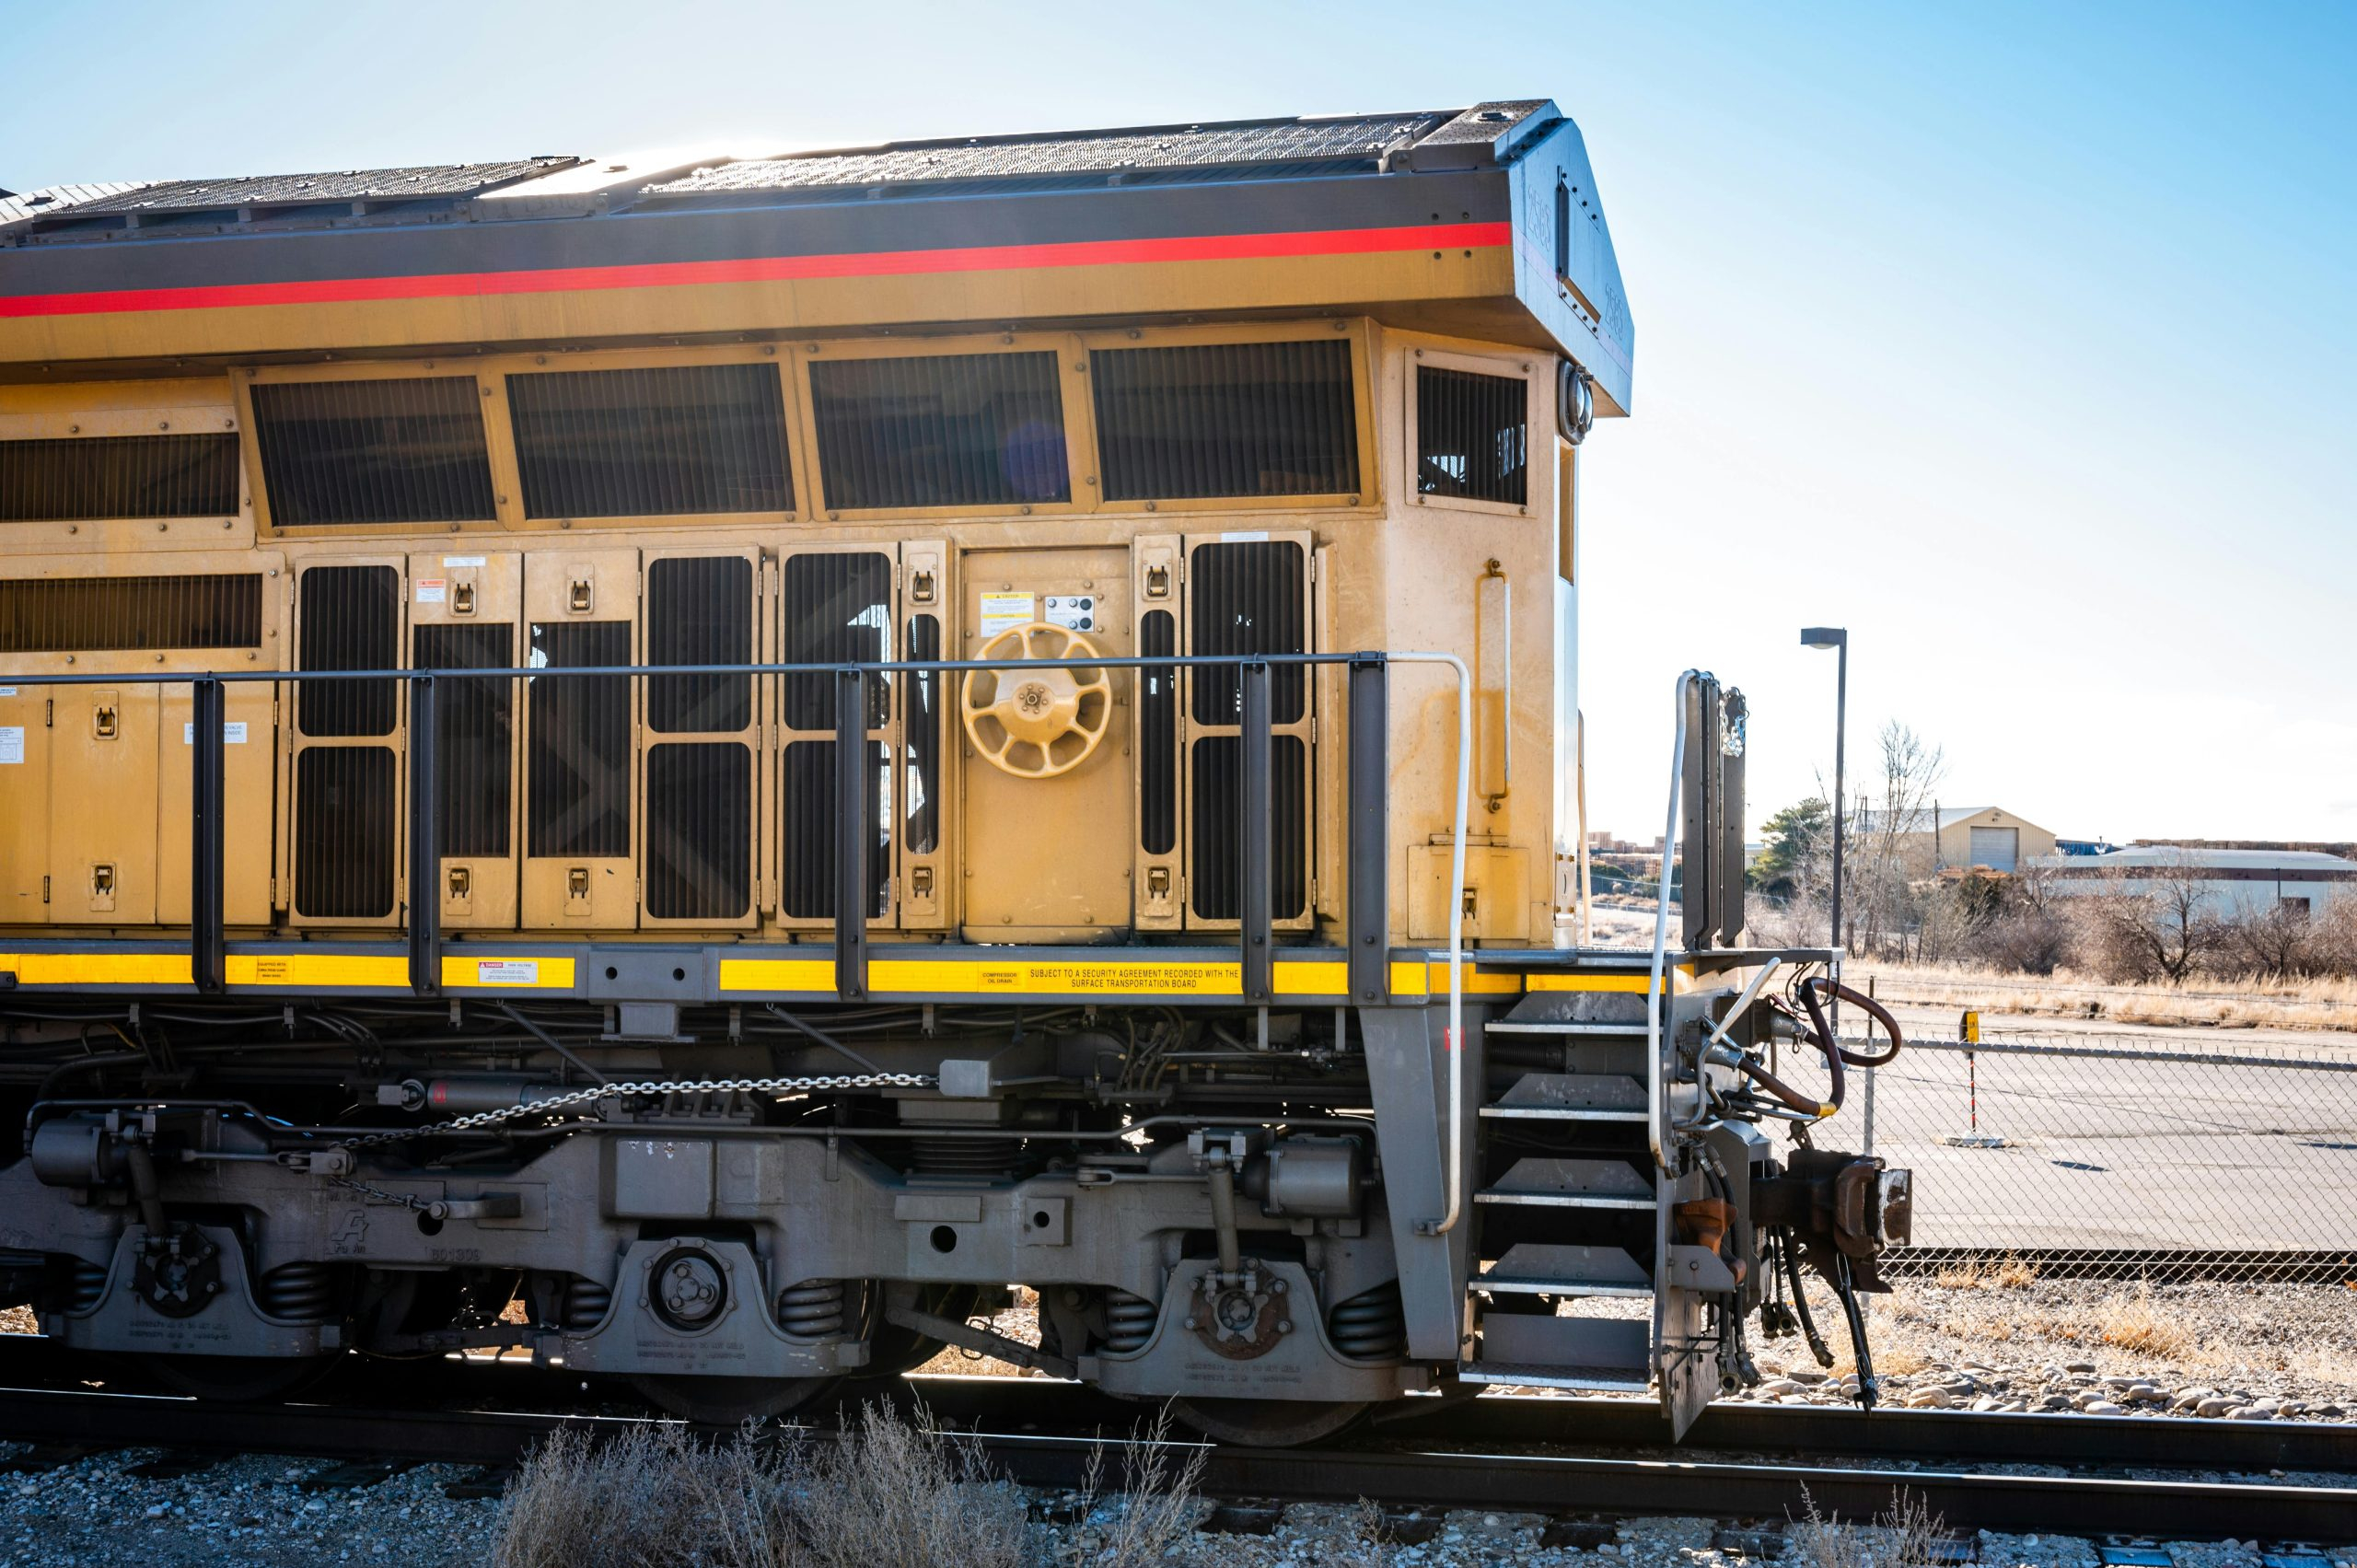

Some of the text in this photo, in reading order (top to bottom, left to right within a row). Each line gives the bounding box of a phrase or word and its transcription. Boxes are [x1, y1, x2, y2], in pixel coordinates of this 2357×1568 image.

[1030, 969, 1238, 978] SUBJECT TO A SECURITY AGREEMENT RECORDED WITH THE
[1072, 979, 1197, 988] SURFACE TRANSPORTATION BOARD
